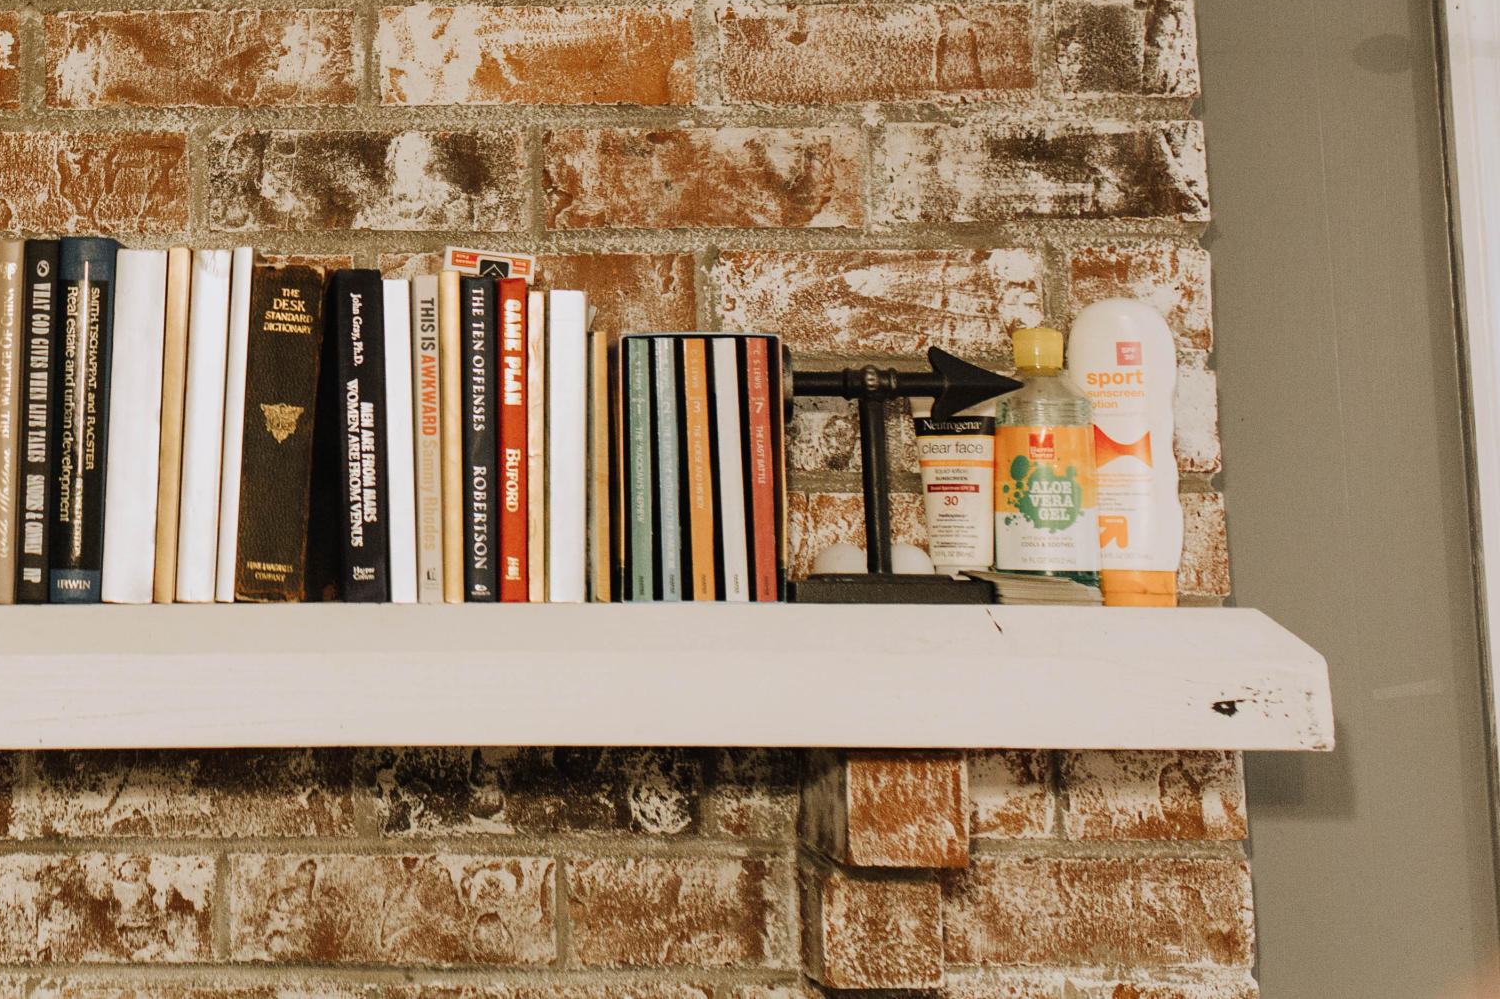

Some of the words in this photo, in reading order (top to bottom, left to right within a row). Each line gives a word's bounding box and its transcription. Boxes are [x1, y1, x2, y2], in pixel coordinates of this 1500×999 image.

[32, 282, 51, 310] WHAT
[67, 286, 79, 316] Real
[273, 298, 306, 312] DESK
[281, 288, 300, 298] THE
[350, 293, 363, 315] John
[472, 287, 485, 317] THE
[32, 313, 50, 335] GOD
[265, 311, 314, 324] STANDARD
[420, 298, 436, 332] THIS
[504, 299, 521, 352] GAME
[66, 318, 77, 358] estate
[263, 322, 312, 335] DICTIONARY
[351, 316, 363, 341] Gray,
[472, 321, 485, 351] TEN
[30, 337, 49, 369] GIVES
[353, 341, 364, 367] Ph.D.
[421, 337, 436, 351] IS
[29, 371, 48, 401] WHEN
[64, 360, 76, 387] and
[504, 356, 522, 406] PLAN
[753, 367, 763, 390] LEWIS
[1086, 369, 1145, 388] sport
[88, 391, 96, 414] and
[347, 378, 360, 433] WOMEN
[420, 354, 437, 436] AWKWARD
[472, 355, 486, 432] OFFENSES
[1085, 390, 1145, 398] sunscreen
[1090, 400, 1118, 409] otion
[28, 404, 47, 428] LIFE
[63, 389, 76, 429] urban
[360, 402, 374, 428] MEN
[693, 401, 701, 414] 3
[755, 402, 764, 414] 7
[693, 424, 702, 438] THE
[755, 425, 765, 439] THE
[923, 419, 981, 433] Neutrogena
[27, 430, 47, 463] TAKES
[85, 416, 96, 471] RACSTER
[348, 433, 361, 460] ARE
[361, 430, 375, 453] ARE
[694, 440, 703, 464] HORSE
[756, 440, 766, 457] LAST
[922, 443, 951, 454] clear
[955, 441, 984, 454] face
[58, 431, 74, 523] development
[362, 453, 376, 487] FROM
[419, 440, 437, 492] Sammy
[757, 459, 766, 485] BATTLE
[349, 461, 362, 502] FROM
[505, 448, 521, 513] BUFORD
[1030, 481, 1072, 494] ALOE
[363, 489, 377, 523] MARS
[944, 495, 959, 506] 30
[1029, 494, 1074, 507] VERA
[25, 511, 44, 520] &
[350, 504, 364, 548] VENUS
[423, 497, 438, 551] Rhodes
[472, 466, 488, 570] ROBERTSON
[1038, 507, 1070, 521] GEL
[57, 579, 91, 590] IRWIN
